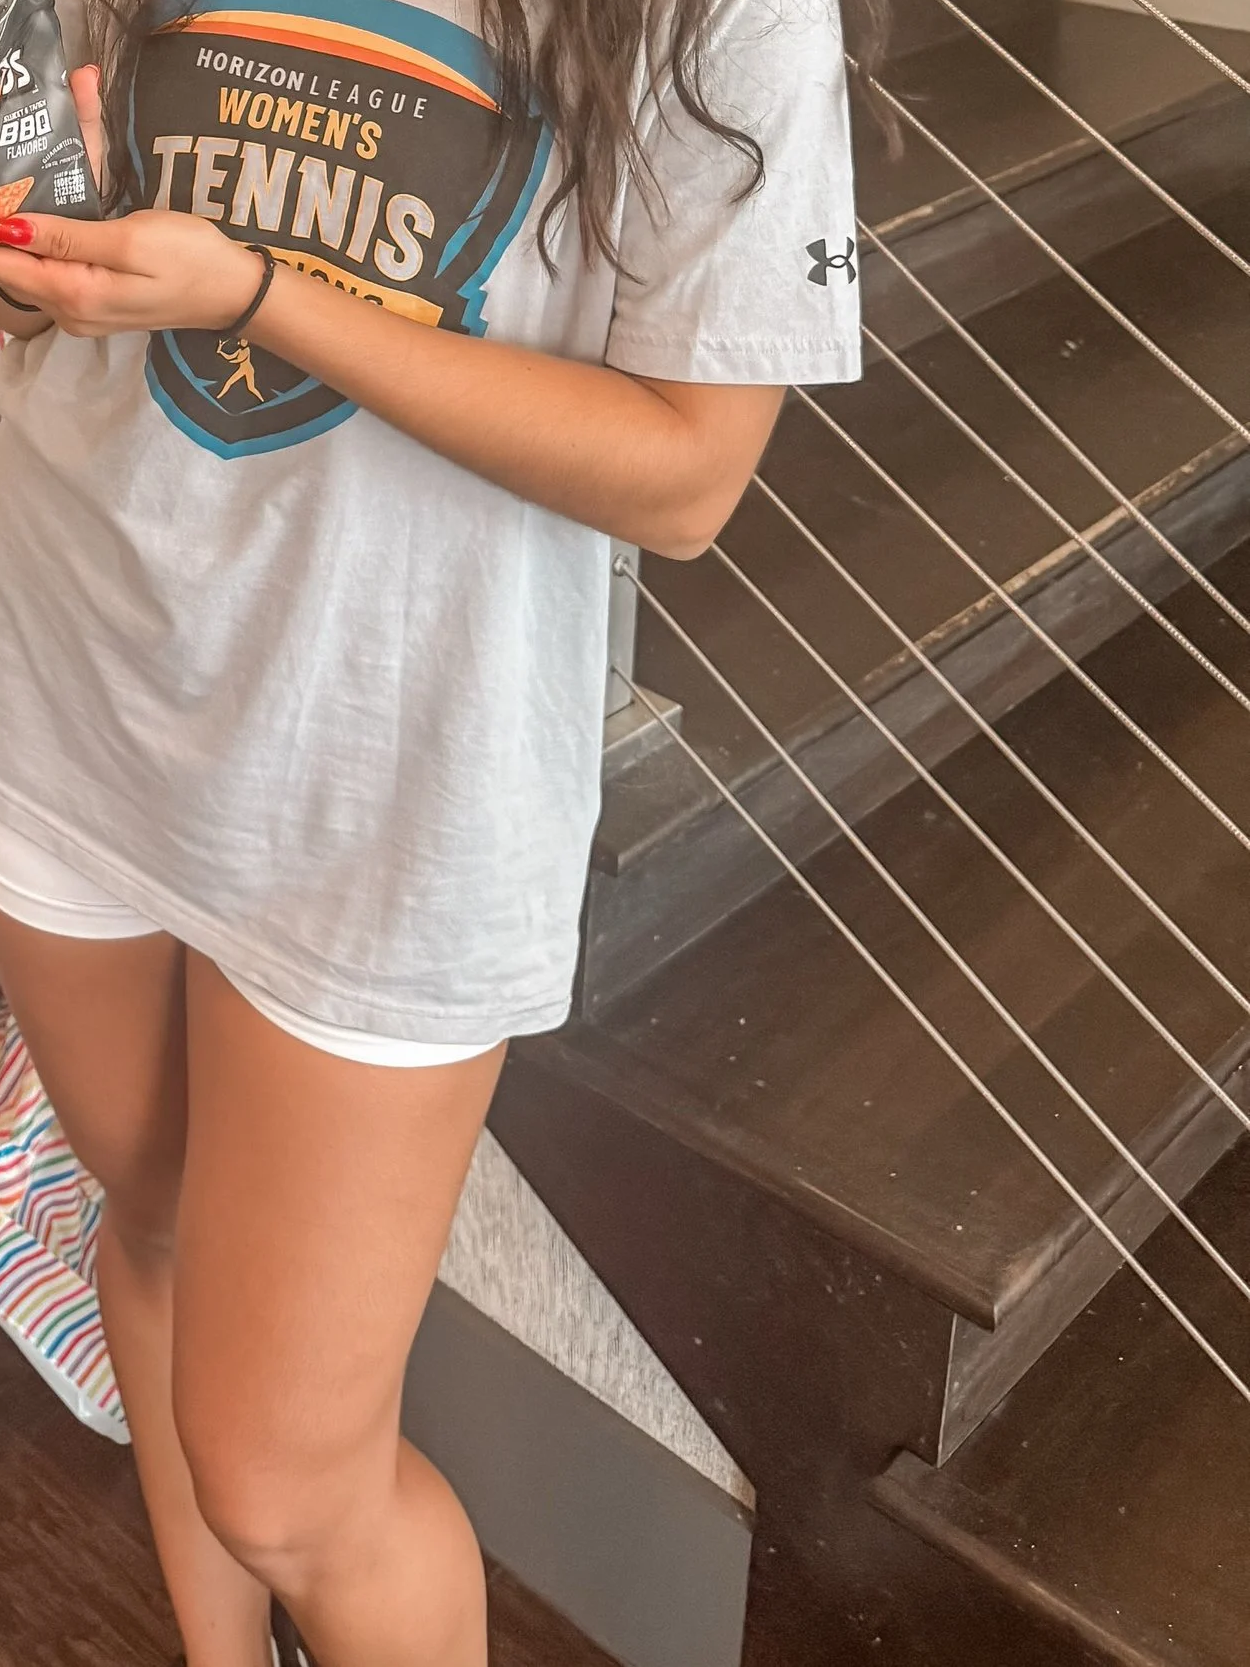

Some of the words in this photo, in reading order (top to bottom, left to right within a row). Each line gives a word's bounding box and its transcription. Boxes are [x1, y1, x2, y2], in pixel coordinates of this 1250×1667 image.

[196, 46, 305, 91] HORIZON
[309, 75, 428, 119] LEAGUE
[0, 108, 52, 147] BBQ
[7, 136, 47, 160] FLAVORED
[218, 86, 383, 160] WOMEN'S
[152, 135, 436, 282] TENNIS
